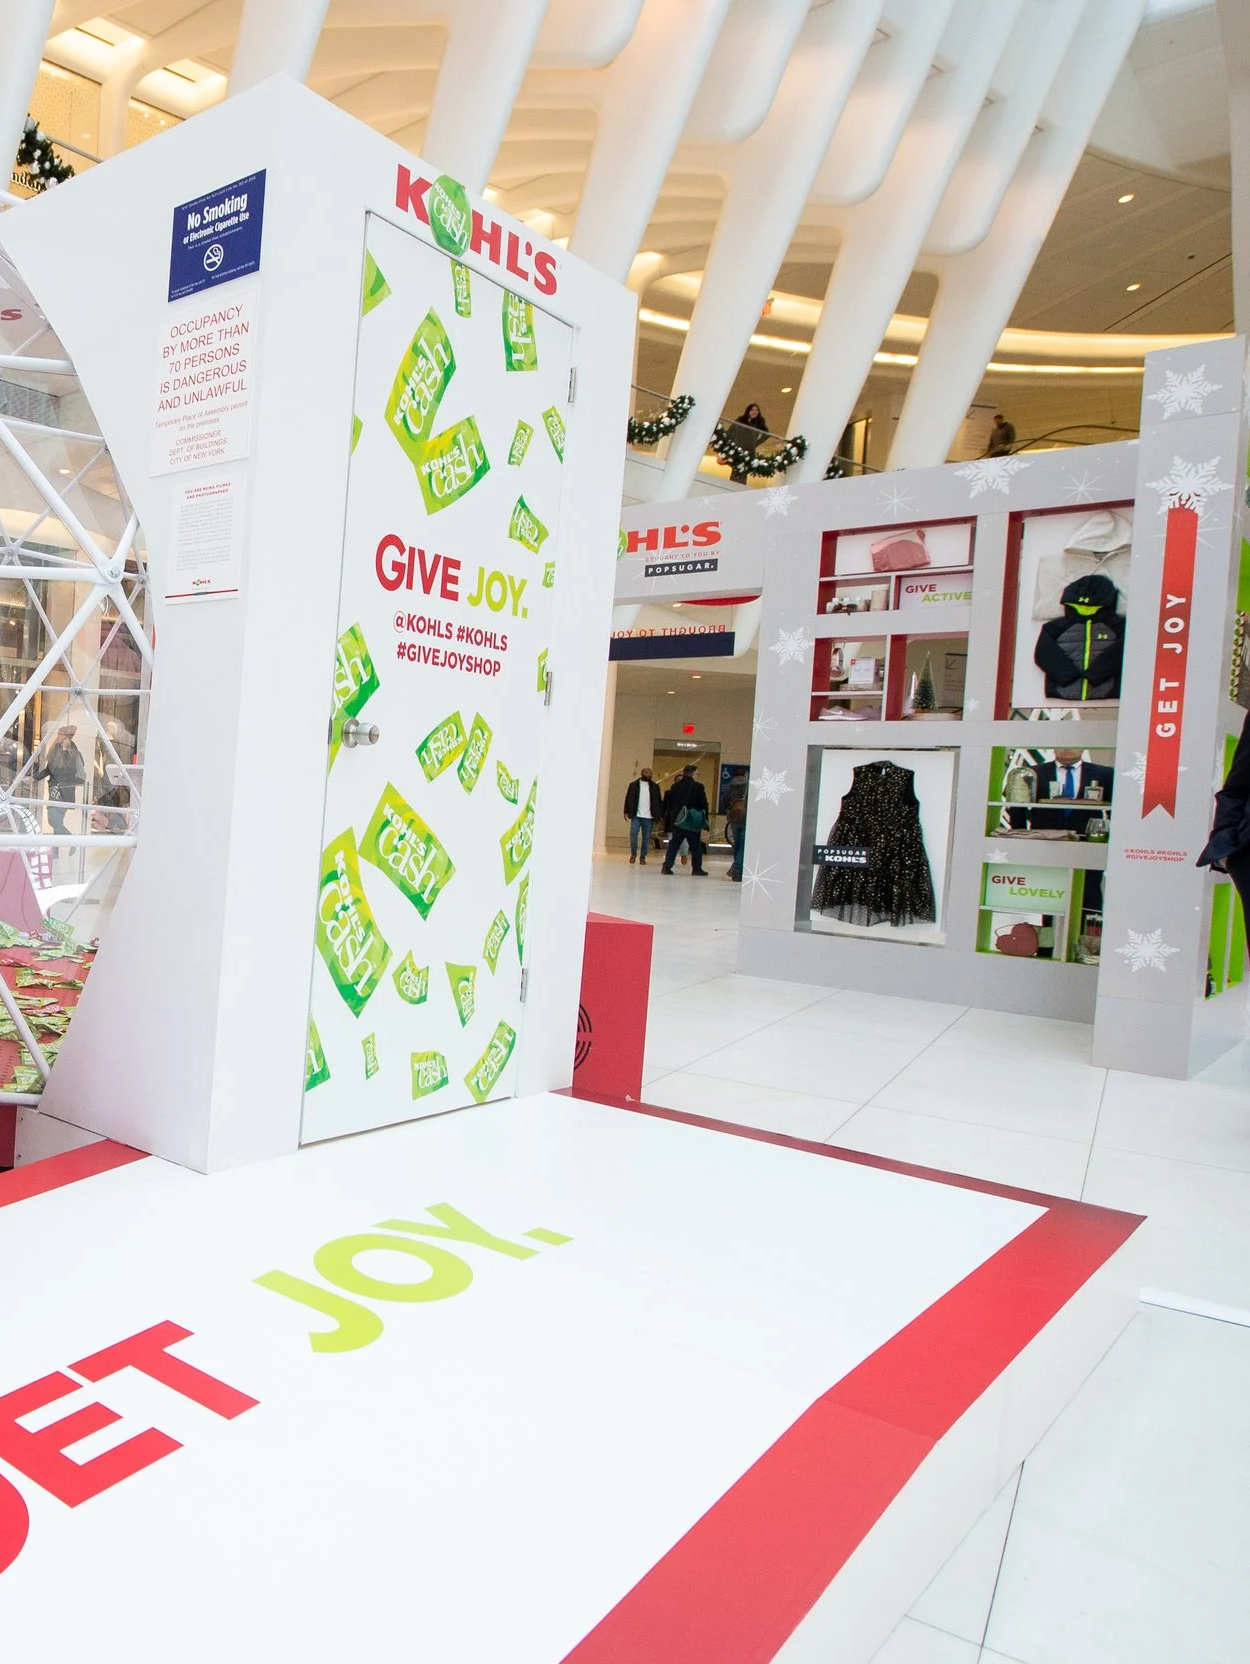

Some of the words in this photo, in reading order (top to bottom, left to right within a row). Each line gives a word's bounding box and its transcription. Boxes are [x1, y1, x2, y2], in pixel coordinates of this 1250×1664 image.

[182, 235, 189, 245] or
[189, 225, 214, 242] Electronic
[214, 216, 238, 233] Cigarette
[239, 211, 250, 222] Use
[187, 212, 201, 231] No
[203, 193, 248, 224] Smoking
[396, 163, 557, 296] KHL'S
[170, 304, 244, 339] OCCUPANCY
[163, 343, 178, 359] BY
[180, 332, 214, 354] MORE
[217, 321, 250, 342] THAN
[160, 381, 170, 394] IS
[173, 359, 247, 391] DANGEROUS
[169, 360, 181, 374] 70
[183, 343, 240, 370] PERSONS
[157, 396, 180, 412] AND
[184, 378, 247, 406] UNLAWFUL
[394, 354, 427, 426] KOHL'S
[407, 337, 451, 434] Cash
[175, 429, 222, 446] COMMISSIONER
[186, 445, 196, 453] OF
[195, 437, 228, 451] BUILDINGS
[169, 456, 183, 465] CITY
[183, 454, 193, 462] OF
[192, 450, 207, 460] NEW
[208, 447, 225, 457] YORK
[421, 445, 461, 476] KOHL'S
[431, 432, 483, 498] Cash
[626, 521, 722, 553] HL'S
[375, 534, 462, 602] GIVE
[467, 566, 529, 619] JOY.
[905, 584, 937, 594] GIVE
[922, 591, 972, 602] ACTIVE
[393, 610, 454, 640] @KOHLS
[456, 625, 508, 652] #KOHLS
[1162, 594, 1187, 654] JOY
[397, 641, 501, 677] #GIVEJOYSHOP
[1155, 678, 1180, 738] GET
[382, 802, 427, 857] KOHL'S
[379, 827, 437, 904] Cash
[825, 855, 867, 864] KOHL'S
[334, 849, 366, 943] KOHL'S
[991, 875, 1026, 886] GIVE
[1010, 887, 1066, 899] LOVELY
[319, 882, 375, 997] Cash
[418, 1055, 448, 1089] Cash
[477, 1032, 515, 1092] Cash
[251, 1201, 575, 1354] JOY.
